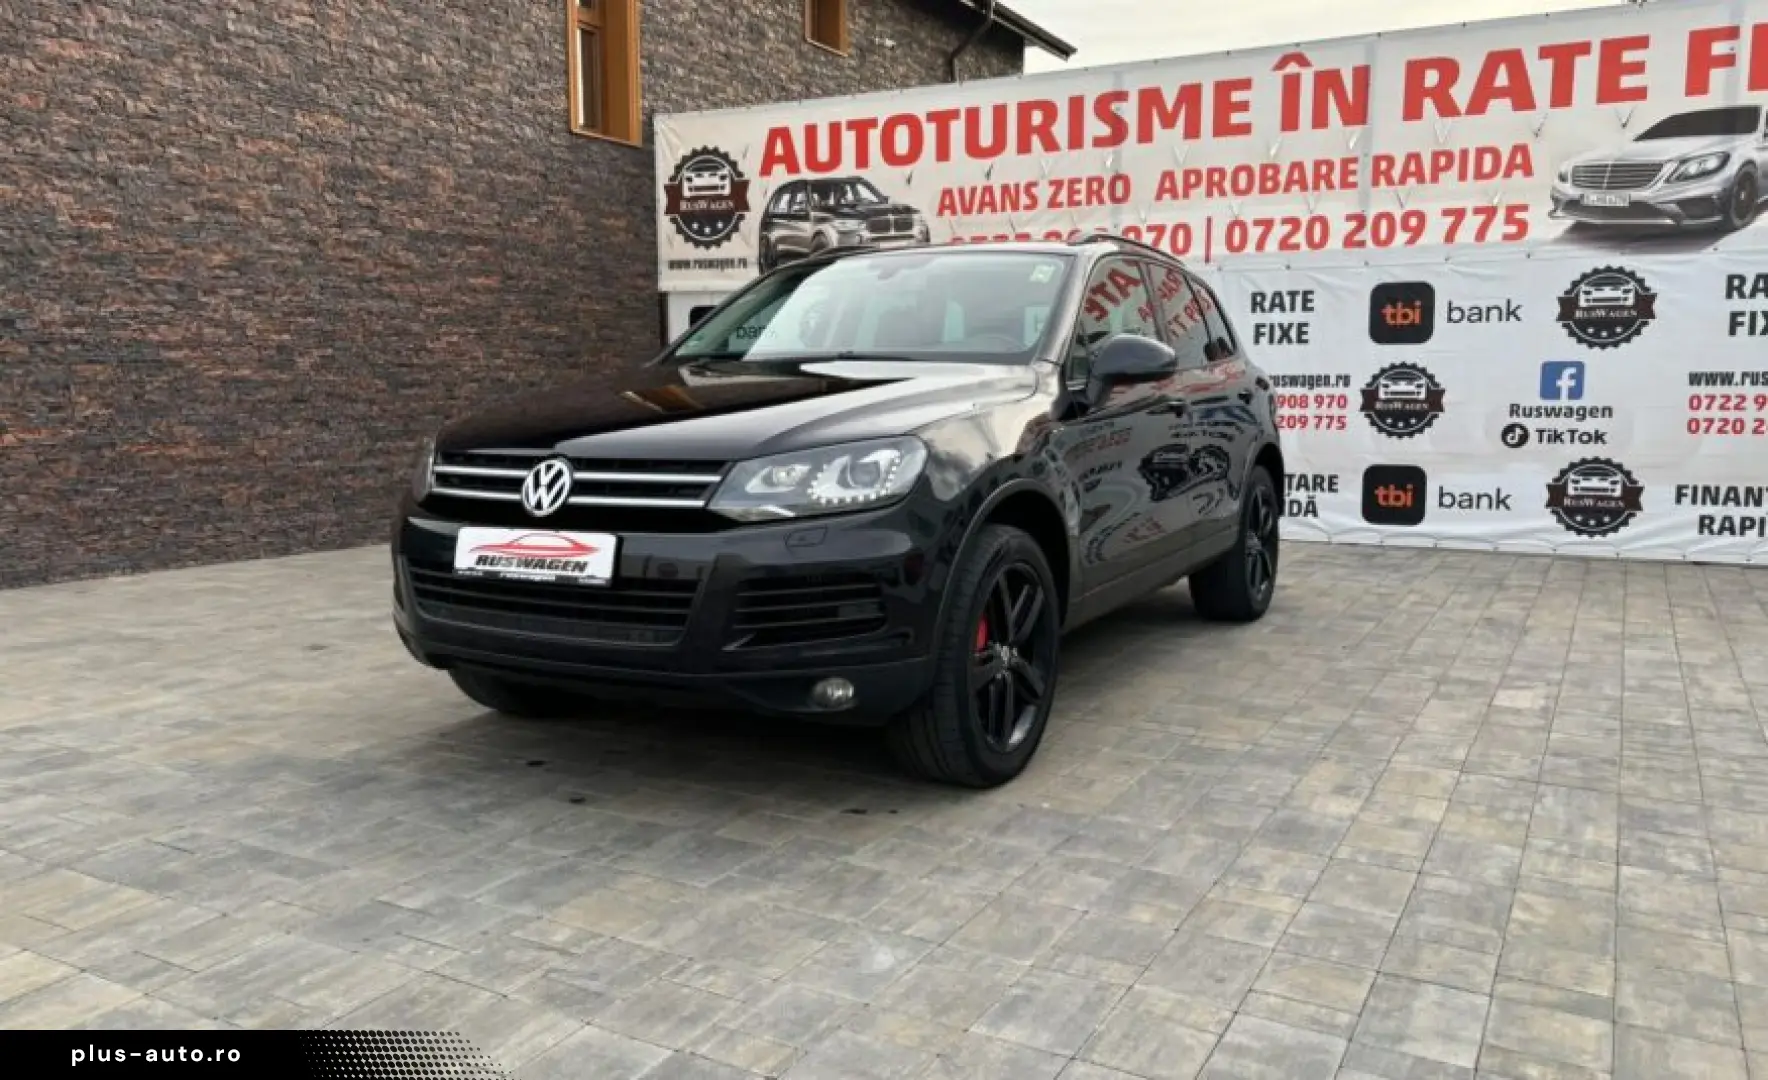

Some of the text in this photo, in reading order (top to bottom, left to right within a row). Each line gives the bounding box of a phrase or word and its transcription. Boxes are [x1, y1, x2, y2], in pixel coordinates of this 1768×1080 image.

[759, 77, 1252, 177] AUTOTURISME
[1272, 52, 1371, 132] ÎN
[1402, 34, 1650, 121] RATE
[936, 143, 1534, 217] AVANS ZERO APROBARE RAPIDA
[1225, 215, 1329, 253] 0720
[1342, 209, 1427, 249] 209
[1441, 203, 1530, 244] 775
[1725, 272, 1768, 300] RA
[1250, 290, 1315, 313] RATE
[1382, 299, 1522, 326] tbi bank
[1253, 323, 1310, 345] FIXE
[1276, 393, 1347, 409] 908 970
[1688, 394, 1747, 411] 0722
[1275, 415, 1347, 430] 209 775
[1509, 403, 1613, 422] Ruswagen
[1536, 428, 1608, 446] TikTok
[1687, 417, 1745, 435] 0720
[1374, 484, 1512, 511] tbi bank
[1675, 484, 1768, 508] FINAN
[475, 554, 589, 573] RUSWAGEN
